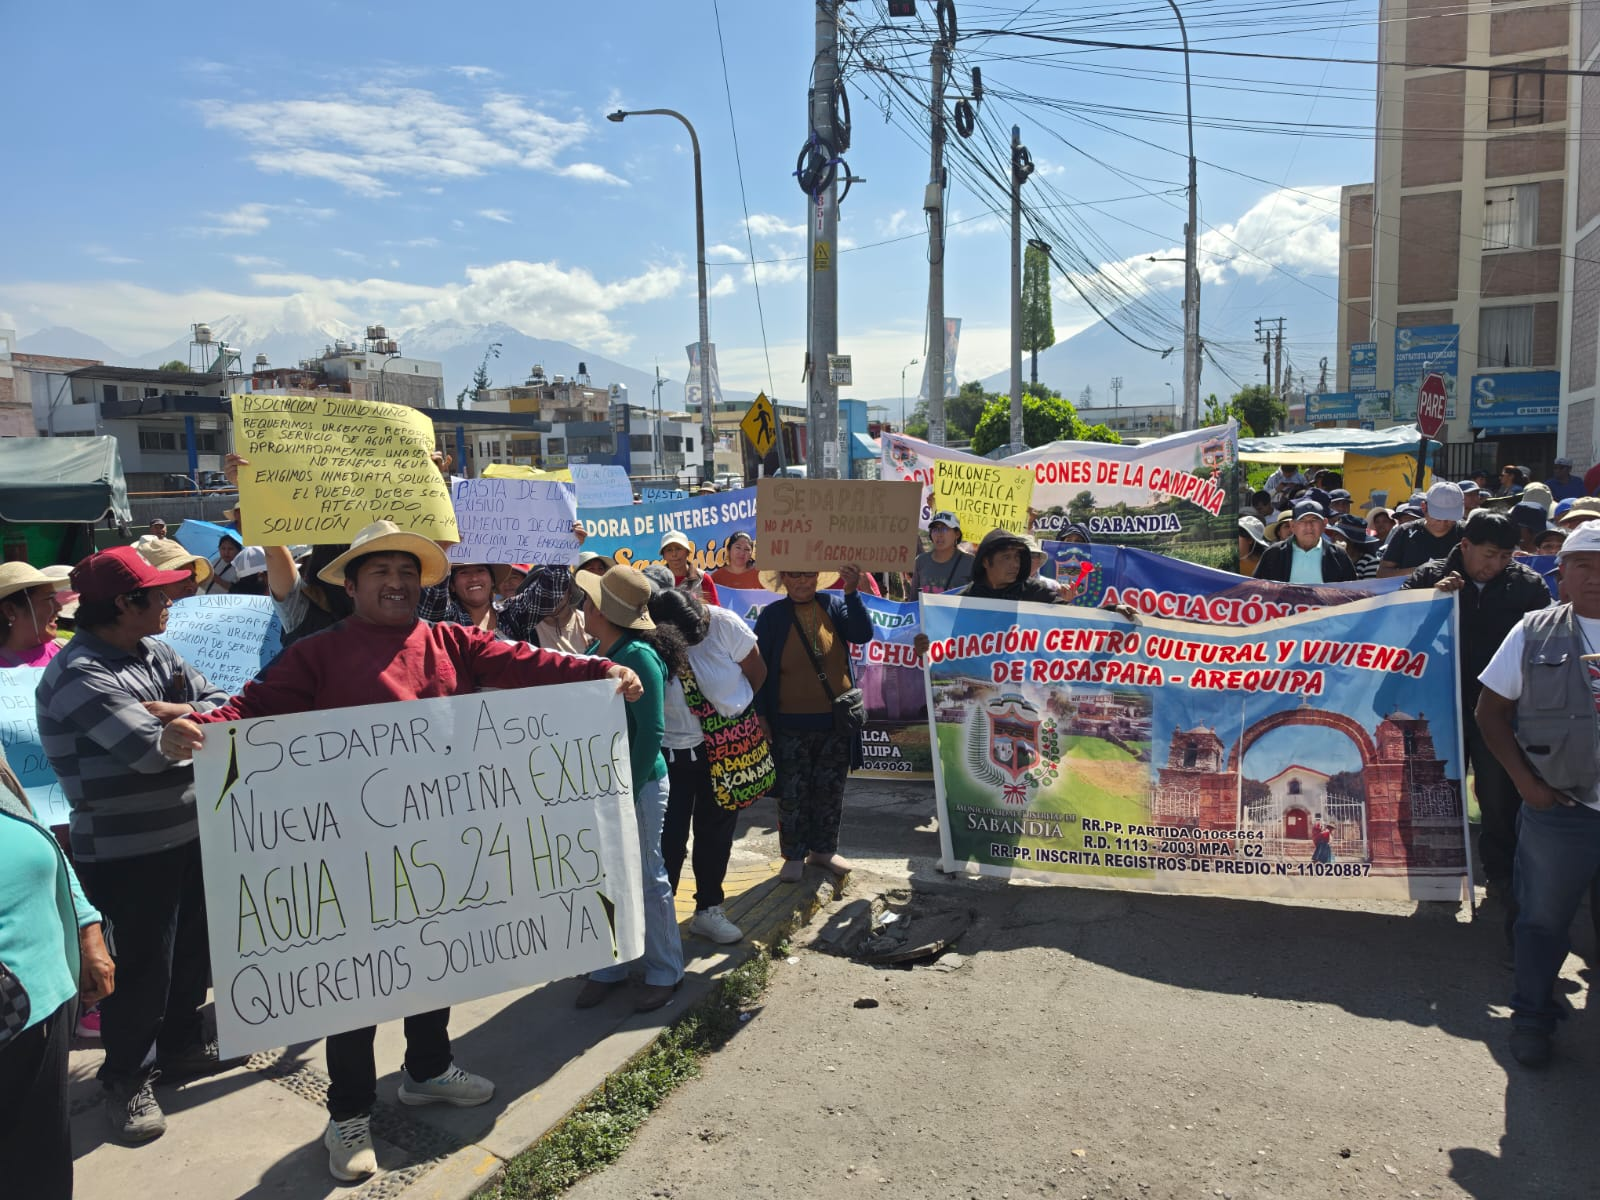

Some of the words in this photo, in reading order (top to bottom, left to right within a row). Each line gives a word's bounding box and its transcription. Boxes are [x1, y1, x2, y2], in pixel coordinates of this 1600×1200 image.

[1420, 391, 1445, 419] PARE
[244, 418, 314, 430] REQUERIMOS
[322, 423, 377, 434] URGENTE
[246, 430, 266, 439] DE
[279, 430, 333, 441] SERVICIO
[342, 434, 360, 444] DE
[365, 436, 393, 446] AGUA
[250, 442, 377, 457] APROXIMADAMENTE
[386, 449, 410, 457] UNA
[310, 457, 331, 467] NO
[333, 457, 387, 467] TENEMOS
[393, 459, 429, 469] AGUA
[938, 462, 1001, 484] BALCONES
[256, 470, 313, 484] EXIGIMOS
[321, 470, 392, 484] INMEDIATA
[293, 488, 309, 500] EL
[315, 485, 365, 499] PUEBLO
[375, 488, 415, 499] DEBE
[420, 488, 447, 501] SER
[457, 480, 508, 500] BASTA
[513, 480, 540, 501] DE
[647, 489, 684, 500] BASTA
[772, 482, 888, 516] SEDAPAR
[940, 480, 1014, 501] UMAPALCA
[1096, 462, 1119, 485] DE
[1123, 463, 1145, 488] LA
[1148, 467, 1226, 515] CAMPIÑA
[321, 499, 422, 514] ATENDIDO
[955, 499, 1018, 518] URGENTE
[410, 513, 436, 528] YA
[634, 516, 657, 537] DE
[658, 508, 718, 532] INTERES
[765, 520, 778, 533] NO
[1090, 514, 1180, 533] SABANDIA
[518, 534, 529, 547] DE
[771, 539, 790, 556] NI
[805, 539, 910, 563] MACROMEDIDOR
[450, 548, 471, 558] CON
[486, 547, 571, 565] CISTERNAS
[1098, 587, 1292, 627] ASOCIACIÓN
[197, 647, 230, 660] AGUA
[929, 626, 1039, 661] OCIACIÓN
[1046, 631, 1140, 657] CENTRO
[1147, 636, 1268, 663] CULTURAL
[1276, 641, 1295, 661] Y
[1304, 641, 1426, 676] VIVIENDA
[193, 659, 215, 669] SIN
[992, 660, 1025, 683] DE
[1033, 660, 1163, 687] ROSASPATA
[1191, 670, 1324, 695] AREQUIPA
[473, 699, 560, 752] ASOC.
[862, 760, 913, 772] 049062
[230, 789, 341, 853] NUEVA
[360, 763, 522, 828] CAMPIÑA
[529, 731, 629, 802] EXIGE
[968, 813, 1065, 839] SABANDIA
[1081, 818, 1124, 833] RR.PP.
[1128, 825, 1189, 838] PARTIDA
[1193, 829, 1265, 840] 01065664
[1084, 835, 1111, 850] R.D.
[1116, 837, 1148, 852] 1113
[1161, 840, 1194, 854] 2003
[1199, 842, 1228, 856] MPA
[1243, 844, 1264, 858] C2
[990, 843, 1031, 860] RR.PP.
[1036, 848, 1101, 867] INSCRITA
[1105, 853, 1186, 871] REGISTROS
[1191, 859, 1210, 872] DE
[1215, 860, 1271, 875] PREDIO
[1298, 862, 1371, 877] 11020887
[237, 857, 347, 952] AGUA
[365, 839, 446, 924] LAS
[457, 821, 514, 906] 24
[526, 814, 606, 892] HRS.
[231, 945, 412, 1026] QUEREMOS
[419, 914, 548, 982] SOLUCION
